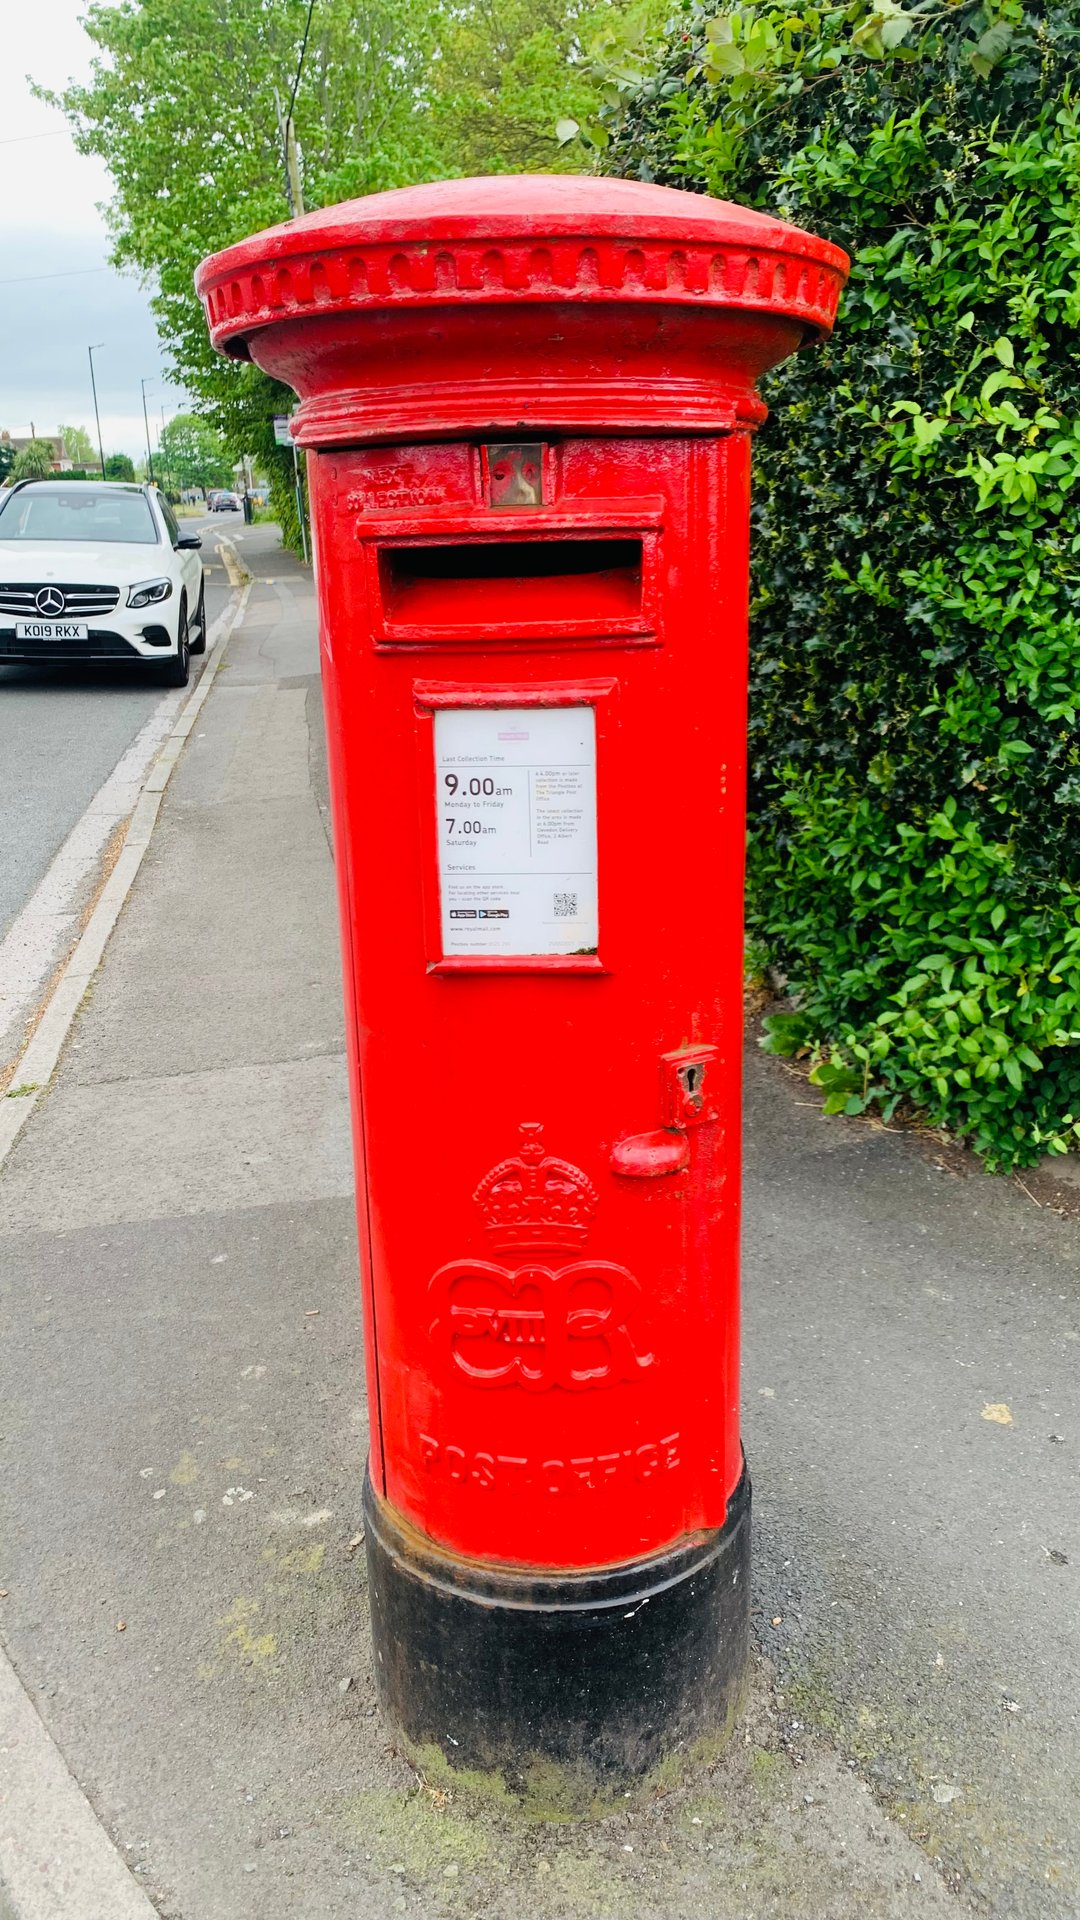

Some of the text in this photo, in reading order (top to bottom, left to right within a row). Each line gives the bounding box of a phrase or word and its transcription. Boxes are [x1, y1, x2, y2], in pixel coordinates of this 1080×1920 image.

[24, 625, 80, 637] KO19 RKX
[445, 773, 513, 796] 9.00am
[444, 801, 472, 809] Monday
[482, 801, 504, 809] Friday
[445, 818, 497, 834] 7.00am
[446, 839, 478, 847] Saturday
[447, 863, 476, 871] Services
[419, 1431, 681, 1496] POST OFFICE
